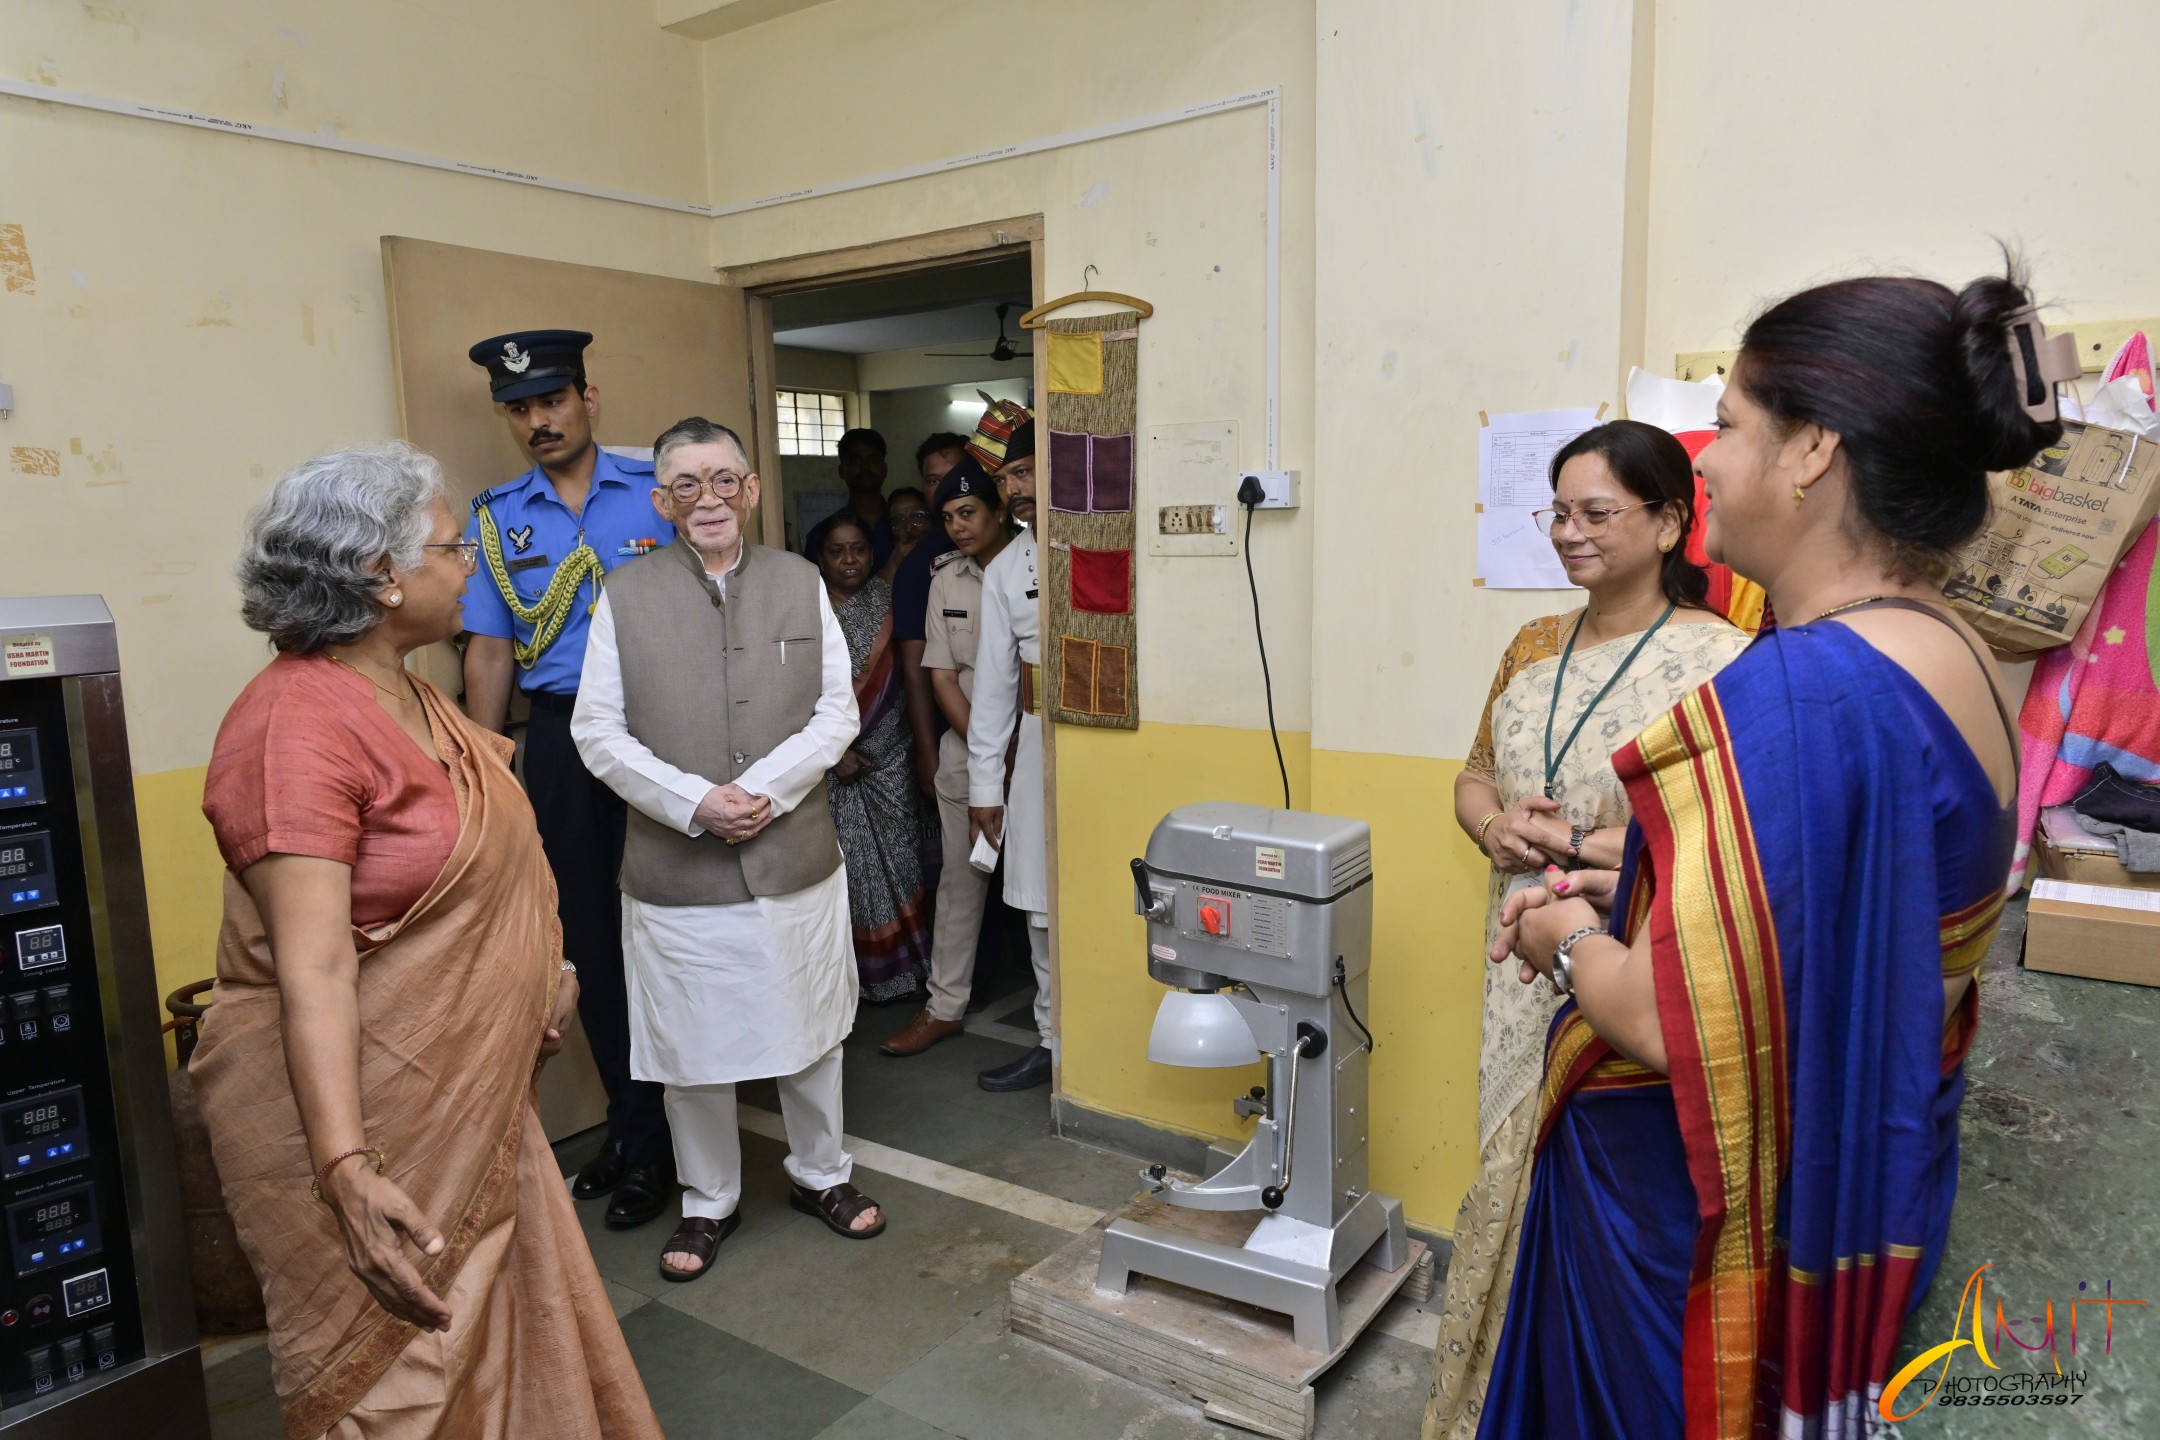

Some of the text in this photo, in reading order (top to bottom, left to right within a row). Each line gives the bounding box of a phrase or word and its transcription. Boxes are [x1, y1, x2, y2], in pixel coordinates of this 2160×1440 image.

[2028, 477, 2109, 512] bigbasket
[2018, 498, 2042, 513] TATA
[2043, 508, 2087, 525] Enterprise
[2050, 525, 2081, 537] delivered
[6, 650, 49, 659] USHA MARTIN
[9, 659, 49, 668] FOUNDATION
[1201, 886, 1220, 896] FOOD
[1220, 889, 1242, 899] MIXER
[6, 1078, 66, 1096] Upper Temperature
[46, 1173, 84, 1187] Temperature
